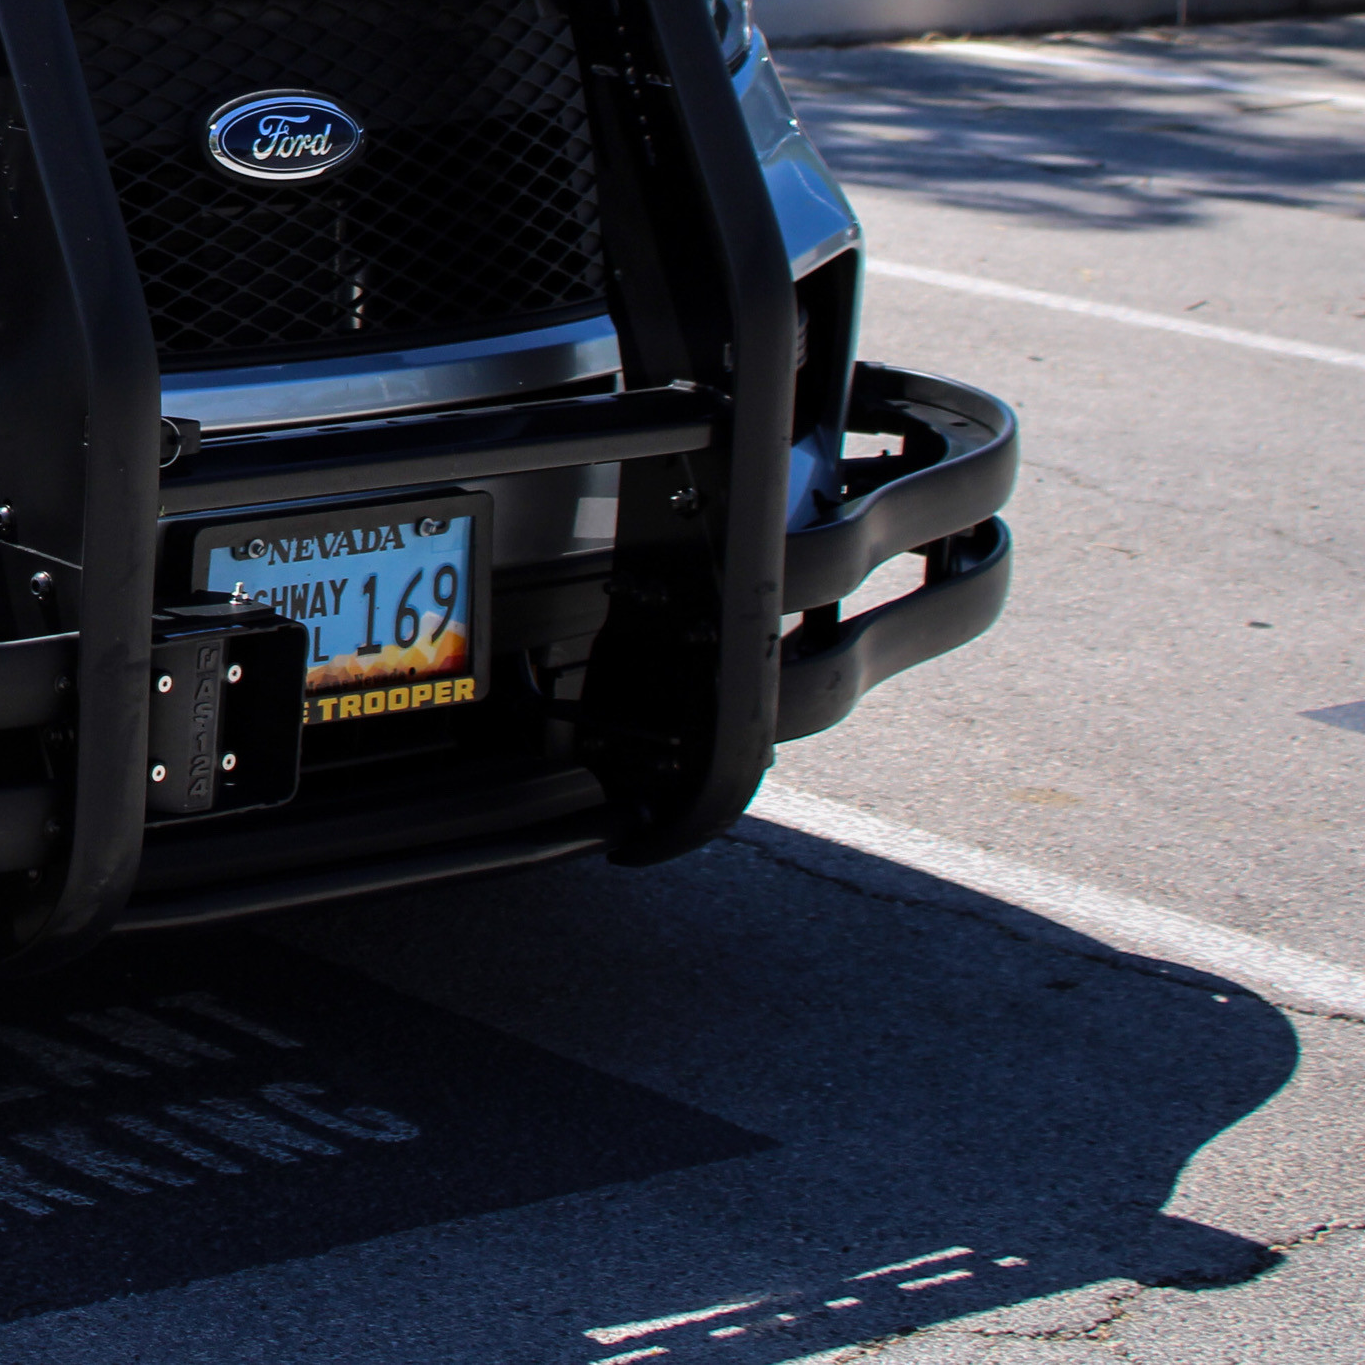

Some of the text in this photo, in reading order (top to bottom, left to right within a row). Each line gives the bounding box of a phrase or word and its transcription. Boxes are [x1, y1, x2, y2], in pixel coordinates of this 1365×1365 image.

[253, 115, 332, 160] Ford
[268, 524, 406, 566] NEVADA
[357, 564, 459, 657] 169
[318, 678, 476, 721] TROOPER
